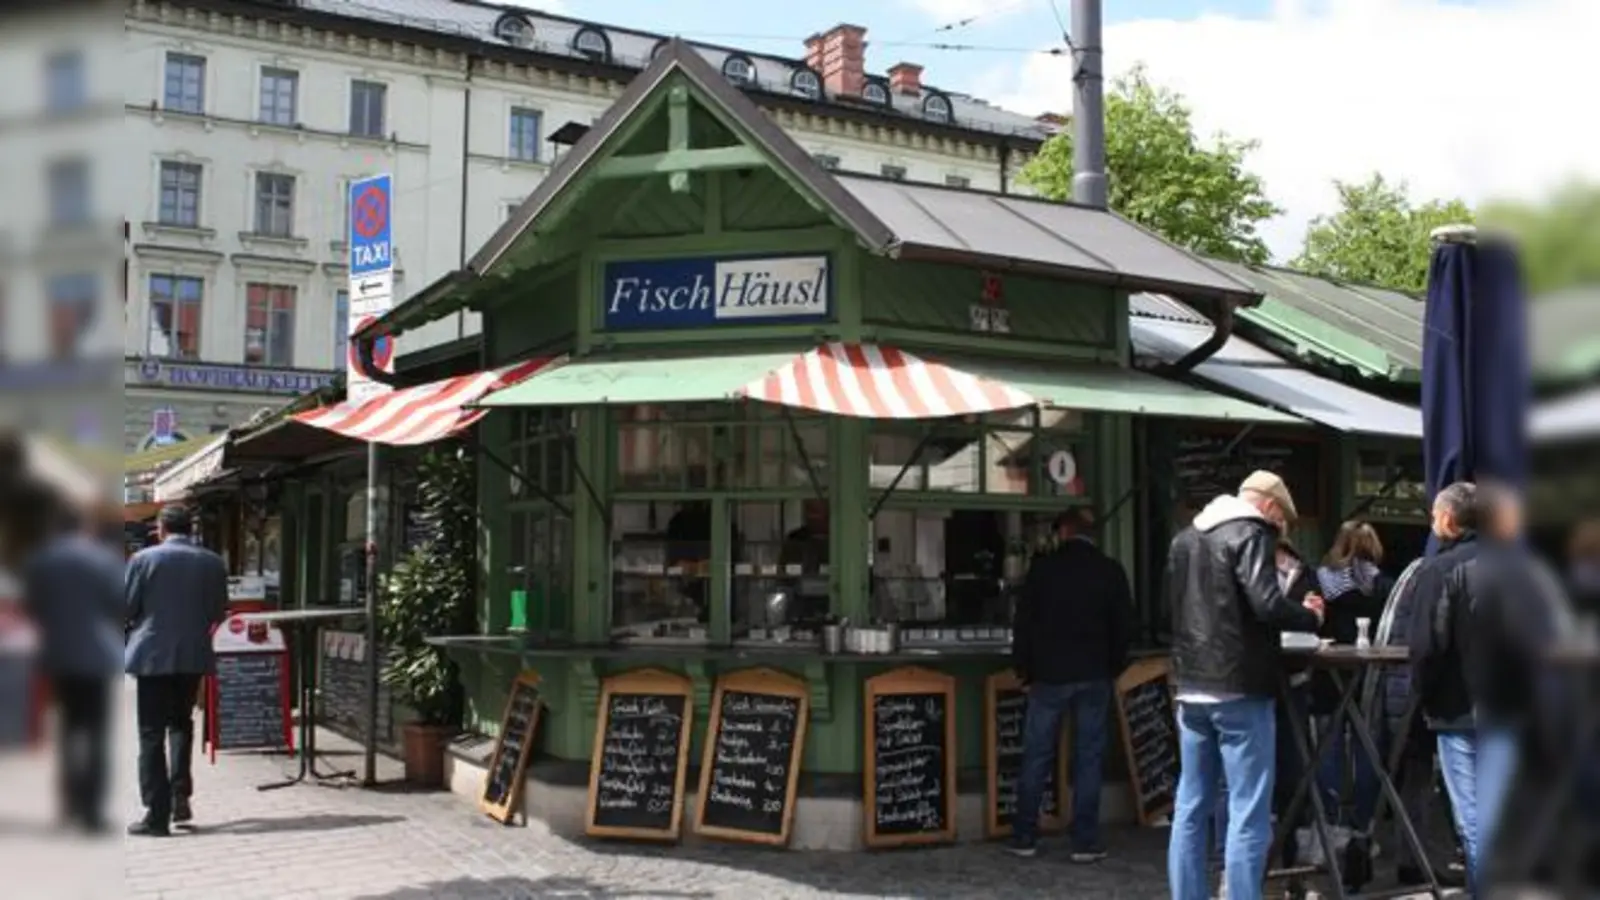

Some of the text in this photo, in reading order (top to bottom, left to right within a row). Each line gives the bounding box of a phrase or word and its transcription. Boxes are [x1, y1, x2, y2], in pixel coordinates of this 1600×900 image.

[353, 241, 389, 266] TAXI
[608, 265, 826, 315] Fisch Häusl
